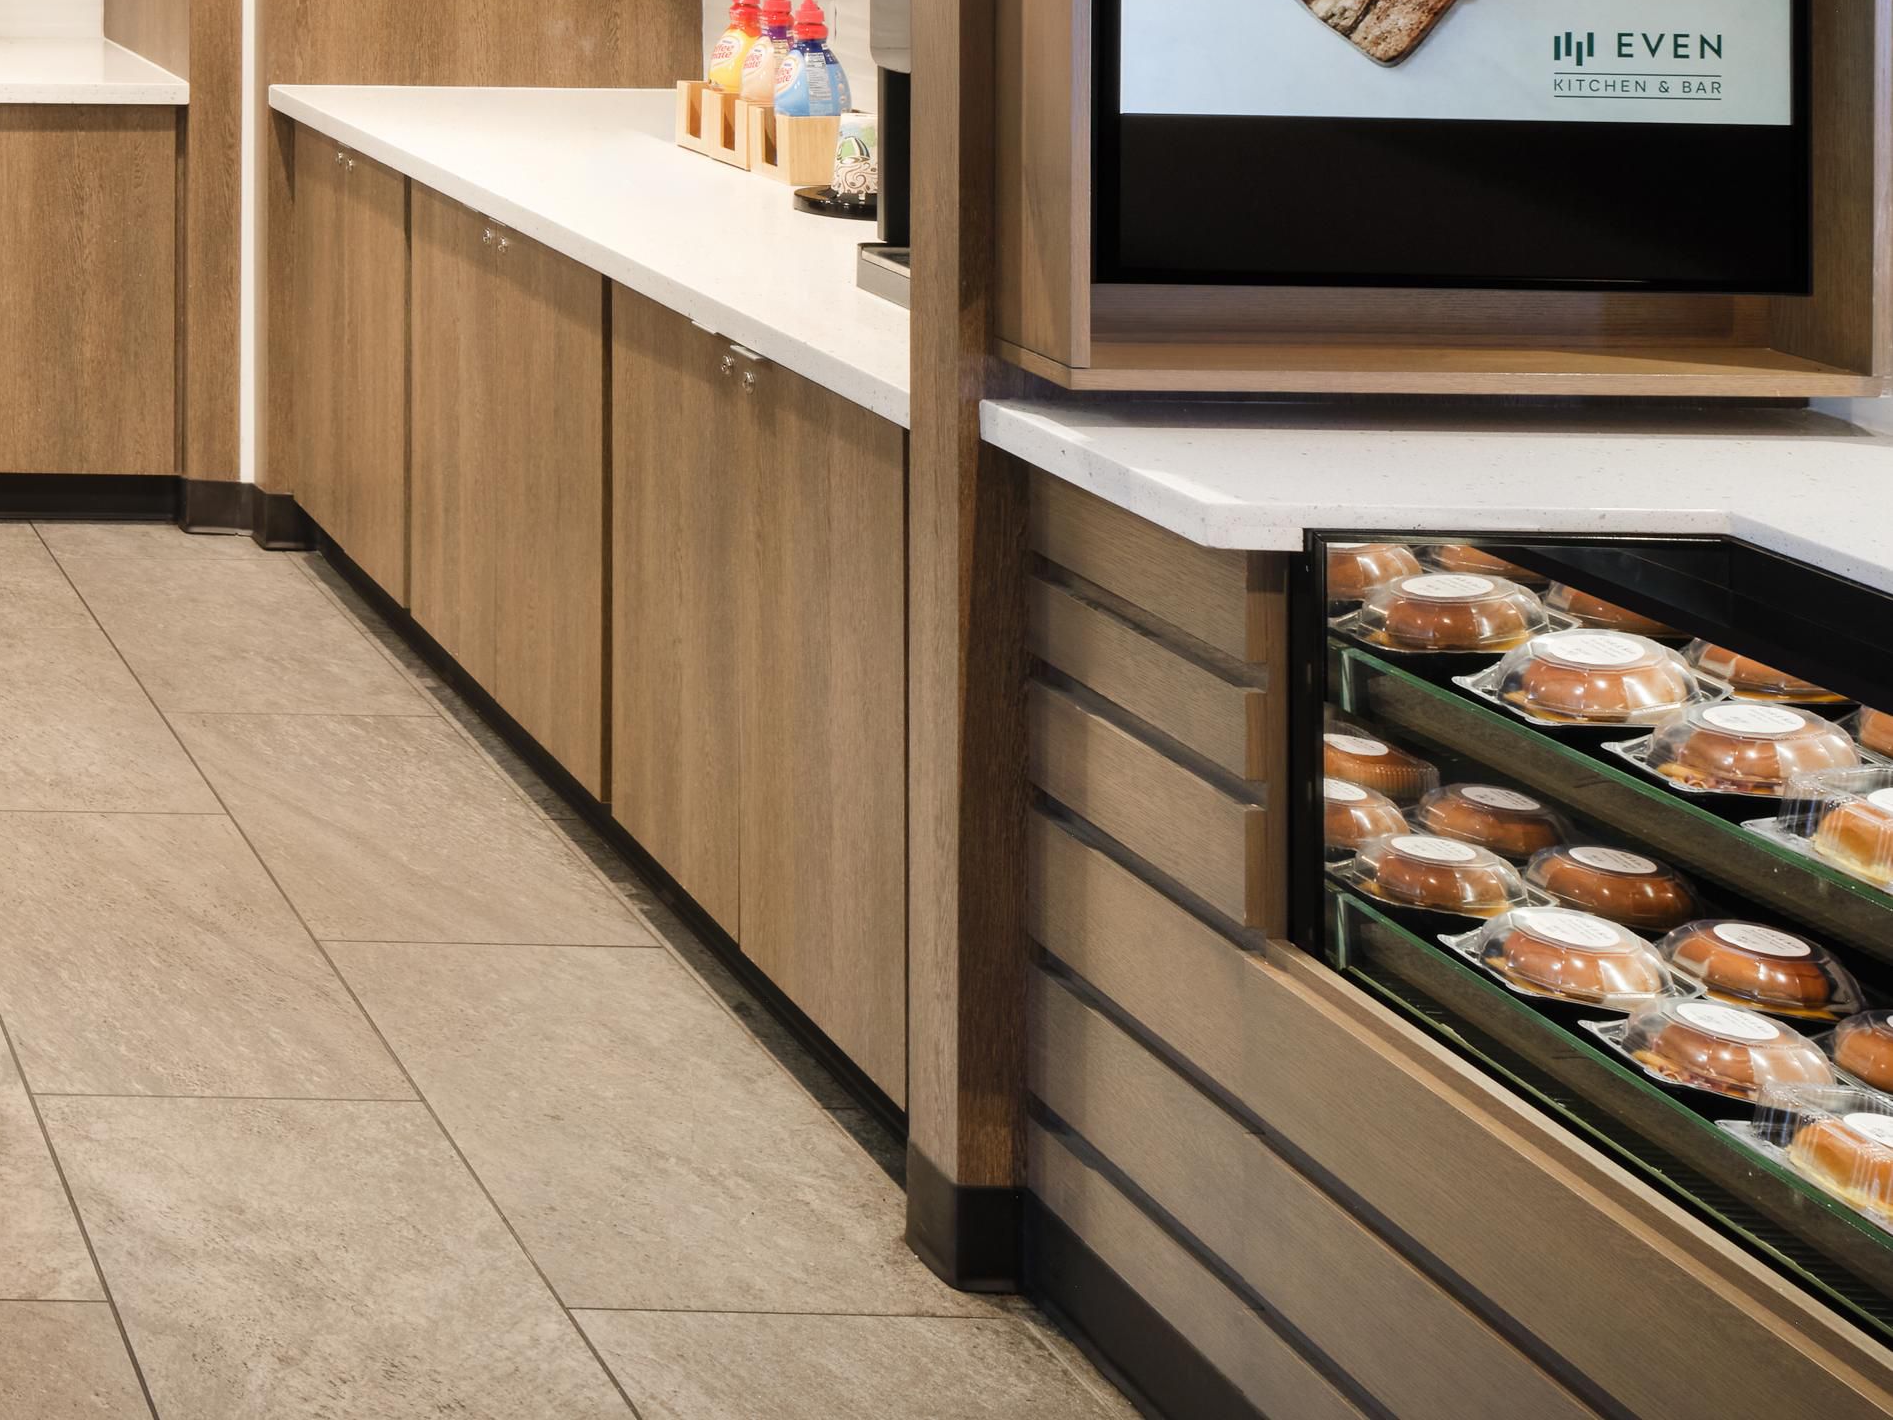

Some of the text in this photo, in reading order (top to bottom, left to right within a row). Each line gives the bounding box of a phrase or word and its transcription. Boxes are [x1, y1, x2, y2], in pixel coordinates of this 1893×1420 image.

[1617, 32, 1722, 60] EVEN
[1553, 78, 1722, 94] KITCHEN & BAR
